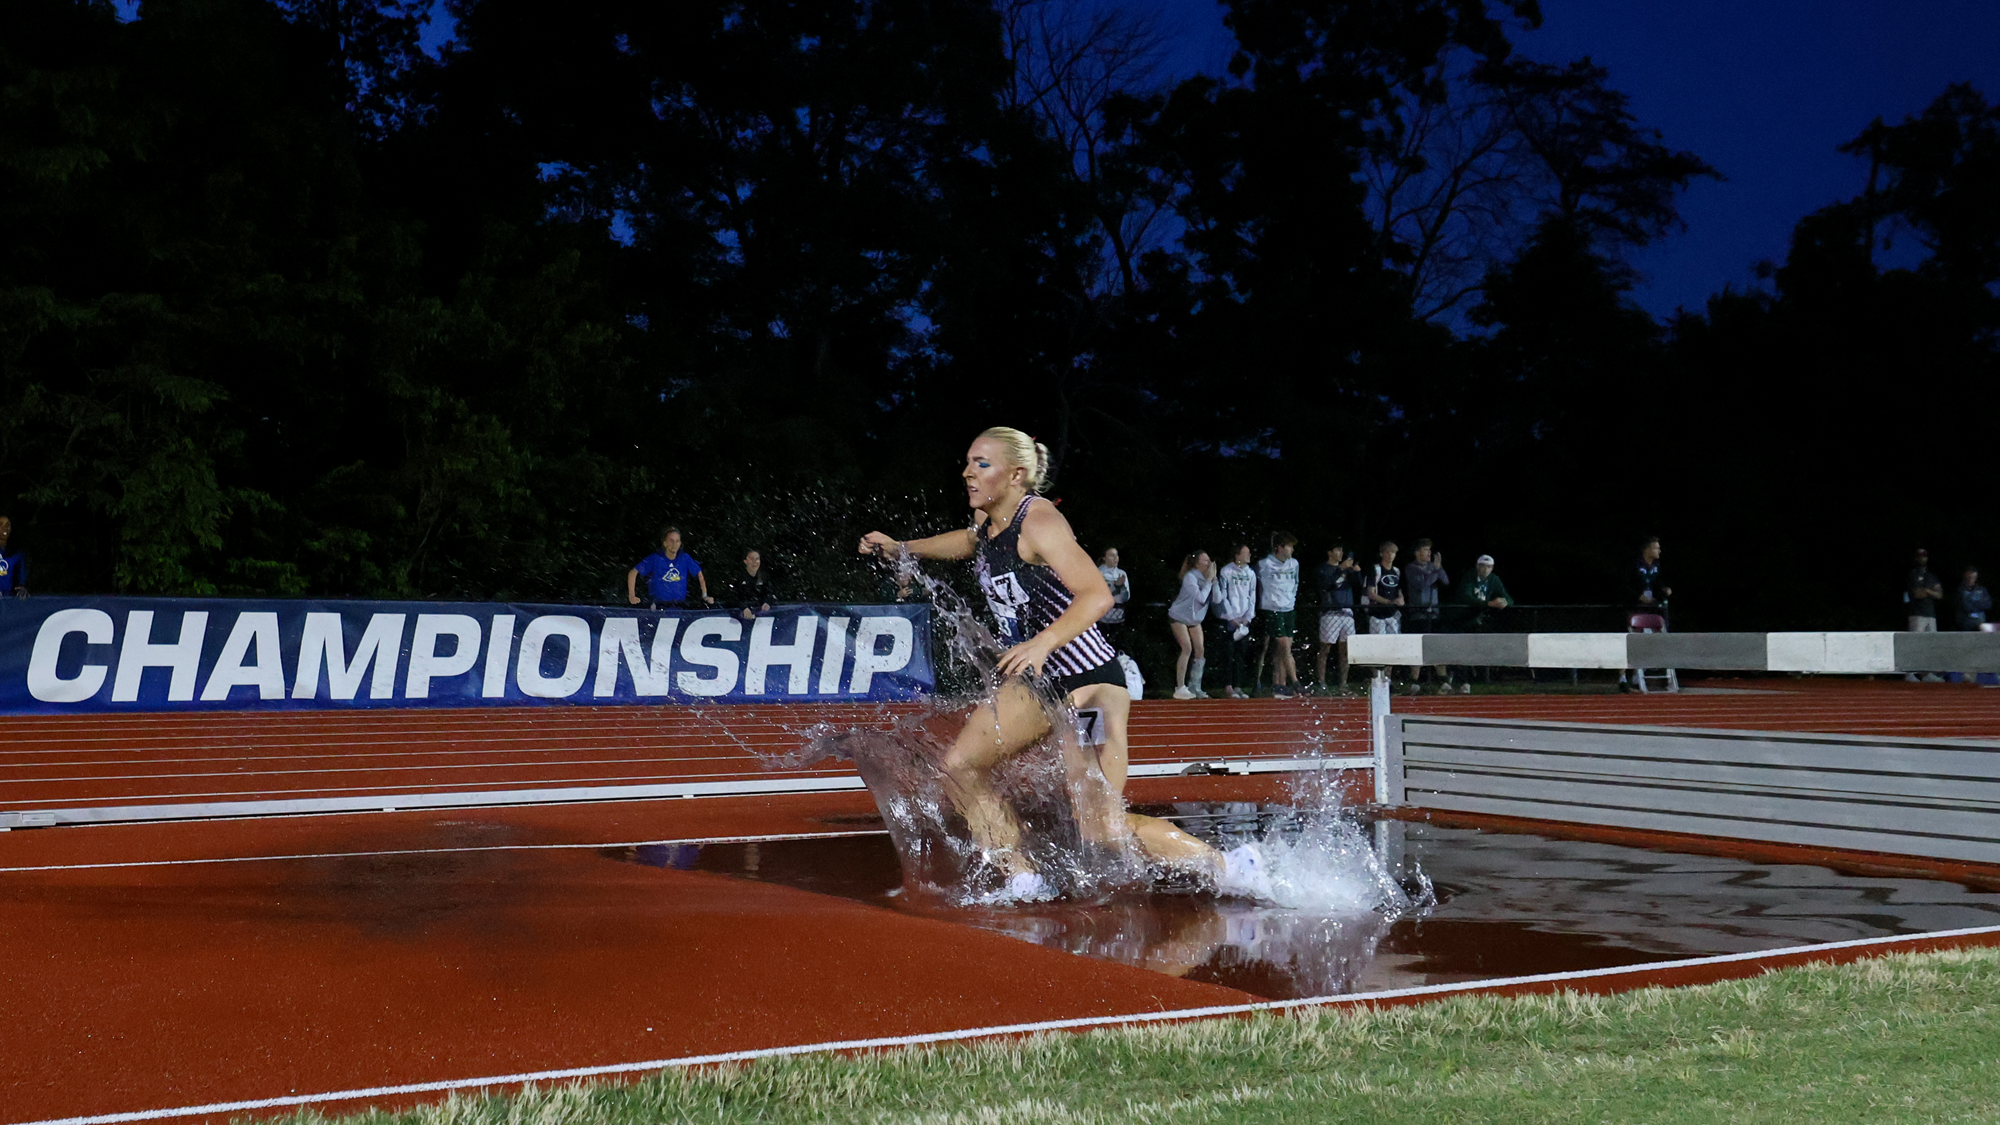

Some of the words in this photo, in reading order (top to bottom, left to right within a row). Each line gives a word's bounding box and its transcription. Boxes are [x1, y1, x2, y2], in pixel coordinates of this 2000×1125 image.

[995, 577, 1016, 604] 7
[27, 608, 913, 703] CHAMPIONSHIP
[1079, 711, 1097, 743] 7
